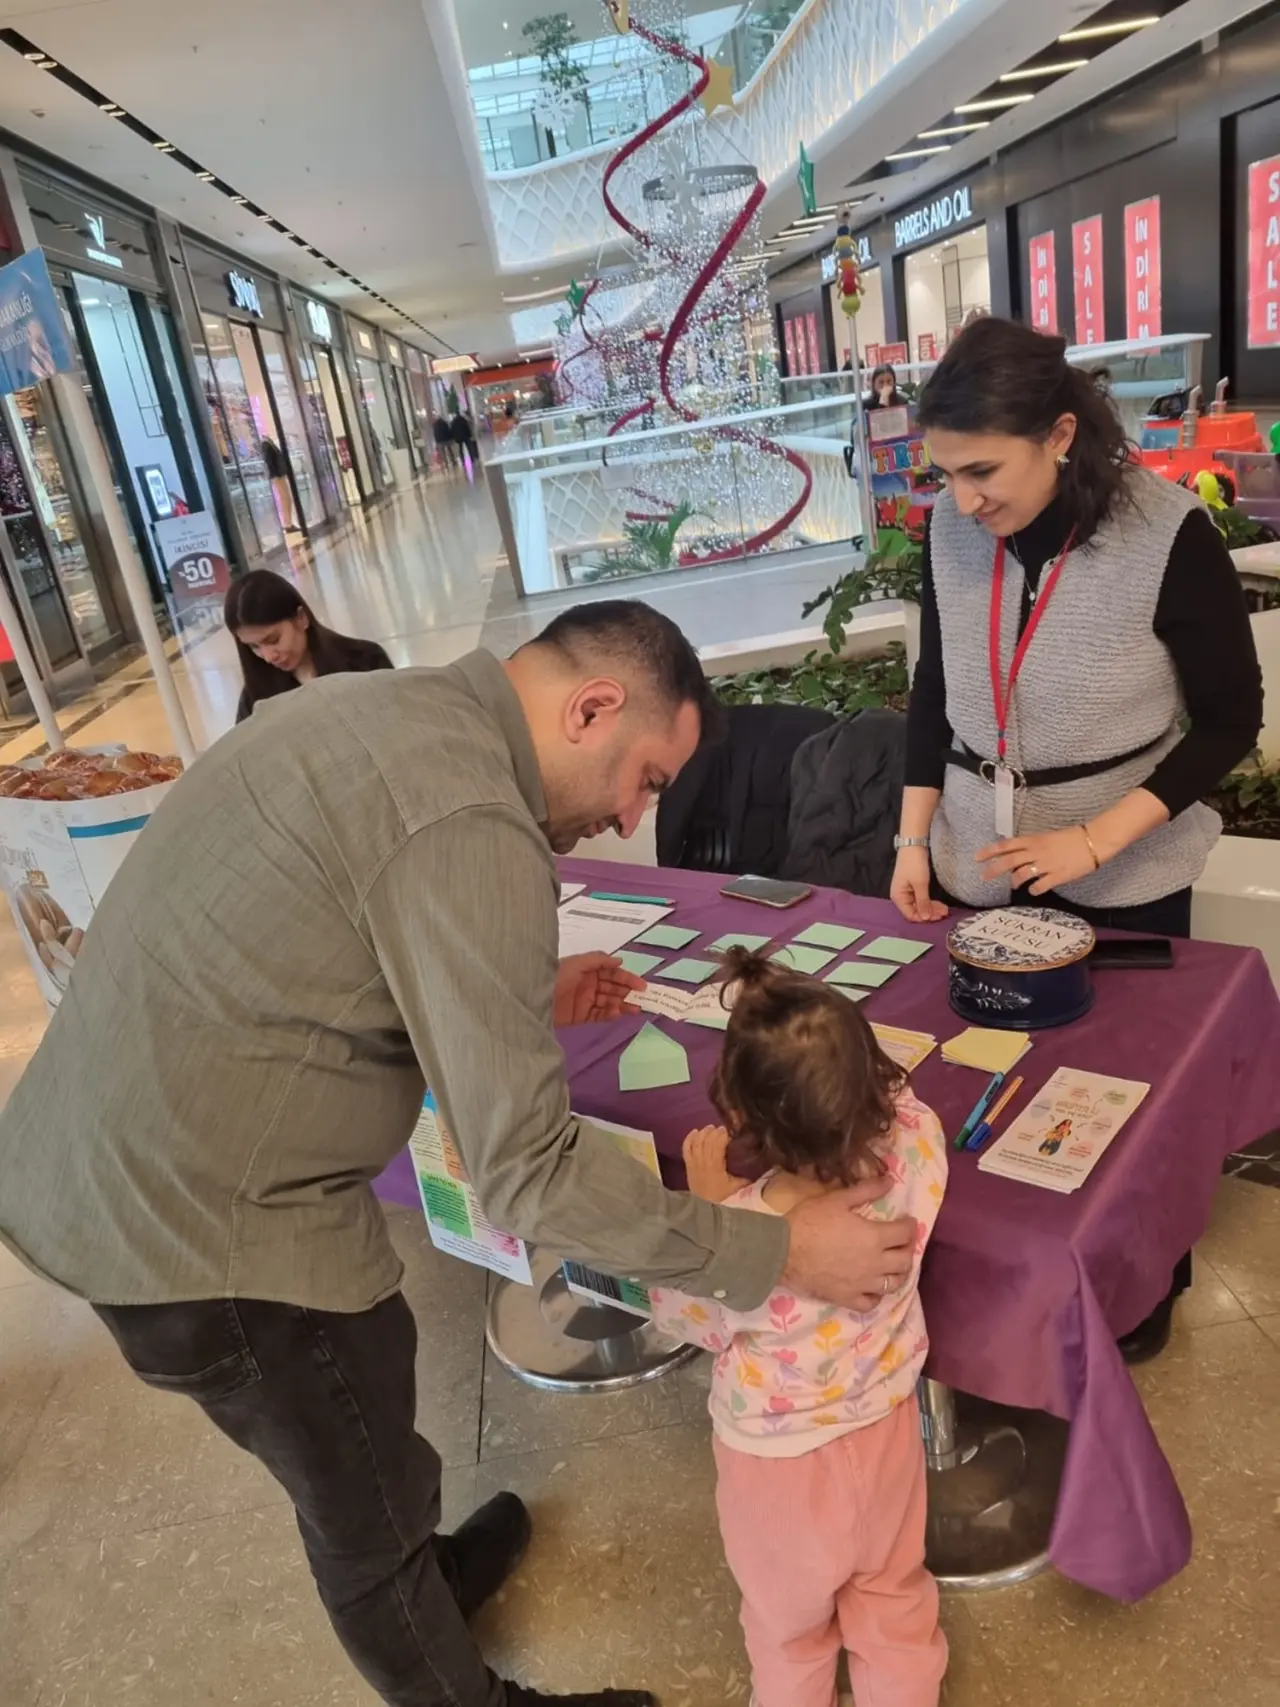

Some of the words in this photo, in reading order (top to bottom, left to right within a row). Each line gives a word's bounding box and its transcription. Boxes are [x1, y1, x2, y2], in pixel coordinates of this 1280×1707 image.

[894, 207, 929, 248] BARRELS
[930, 196, 953, 231] AND
[953, 186, 972, 221] OIL
[872, 440, 931, 473] TIRTI
